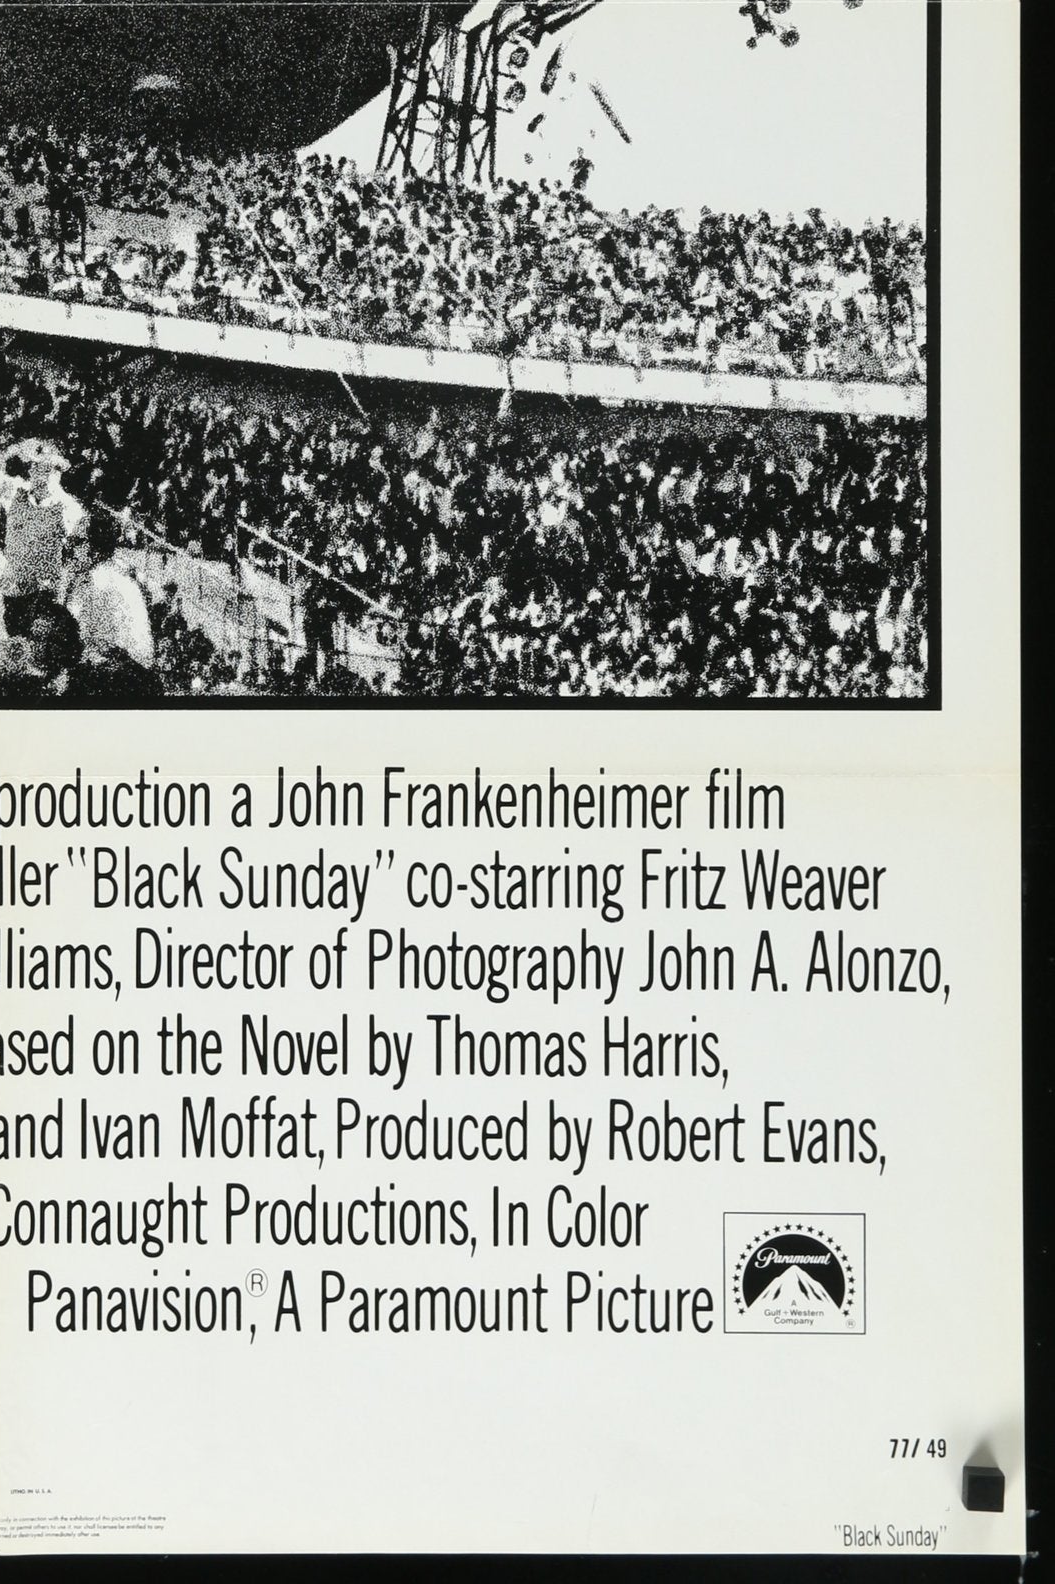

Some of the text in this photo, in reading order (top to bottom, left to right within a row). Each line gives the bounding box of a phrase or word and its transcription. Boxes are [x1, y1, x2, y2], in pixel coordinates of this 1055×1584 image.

[232, 783, 251, 827] a
[269, 766, 363, 828] John
[384, 767, 689, 829] Frankenheimer
[706, 768, 783, 829] film
[407, 848, 624, 923] co-starring
[642, 848, 726, 910] Fritz
[742, 849, 886, 911] Weaver
[136, 927, 293, 989] Director
[310, 927, 347, 989] of
[369, 928, 623, 1004] Photography
[640, 929, 733, 991] John
[751, 931, 787, 991] A.
[806, 930, 949, 1004] Alonzo,
[93, 1030, 138, 1075] on
[157, 1013, 222, 1075] the
[242, 1014, 347, 1076] Novel
[370, 1015, 412, 1090] by
[427, 1014, 586, 1077] Thomas
[605, 1016, 728, 1088] Harris,
[81, 1099, 159, 1159] Ivan
[182, 1096, 324, 1169] Moffat,
[338, 1098, 527, 1161] Produced
[550, 1100, 592, 1175] by
[609, 1099, 745, 1162] Robert
[764, 1102, 885, 1174] Evans,
[226, 1183, 476, 1256] Productions,
[494, 1186, 528, 1246] In
[548, 1185, 649, 1247] Color
[754, 1246, 831, 1269] Paramount
[275, 1271, 301, 1331] A
[322, 1271, 548, 1333] Paramount
[567, 1271, 713, 1333] Picture
[764, 1309, 781, 1317] Gulf
[790, 1309, 825, 1317] Western
[774, 1317, 814, 1326] Company
